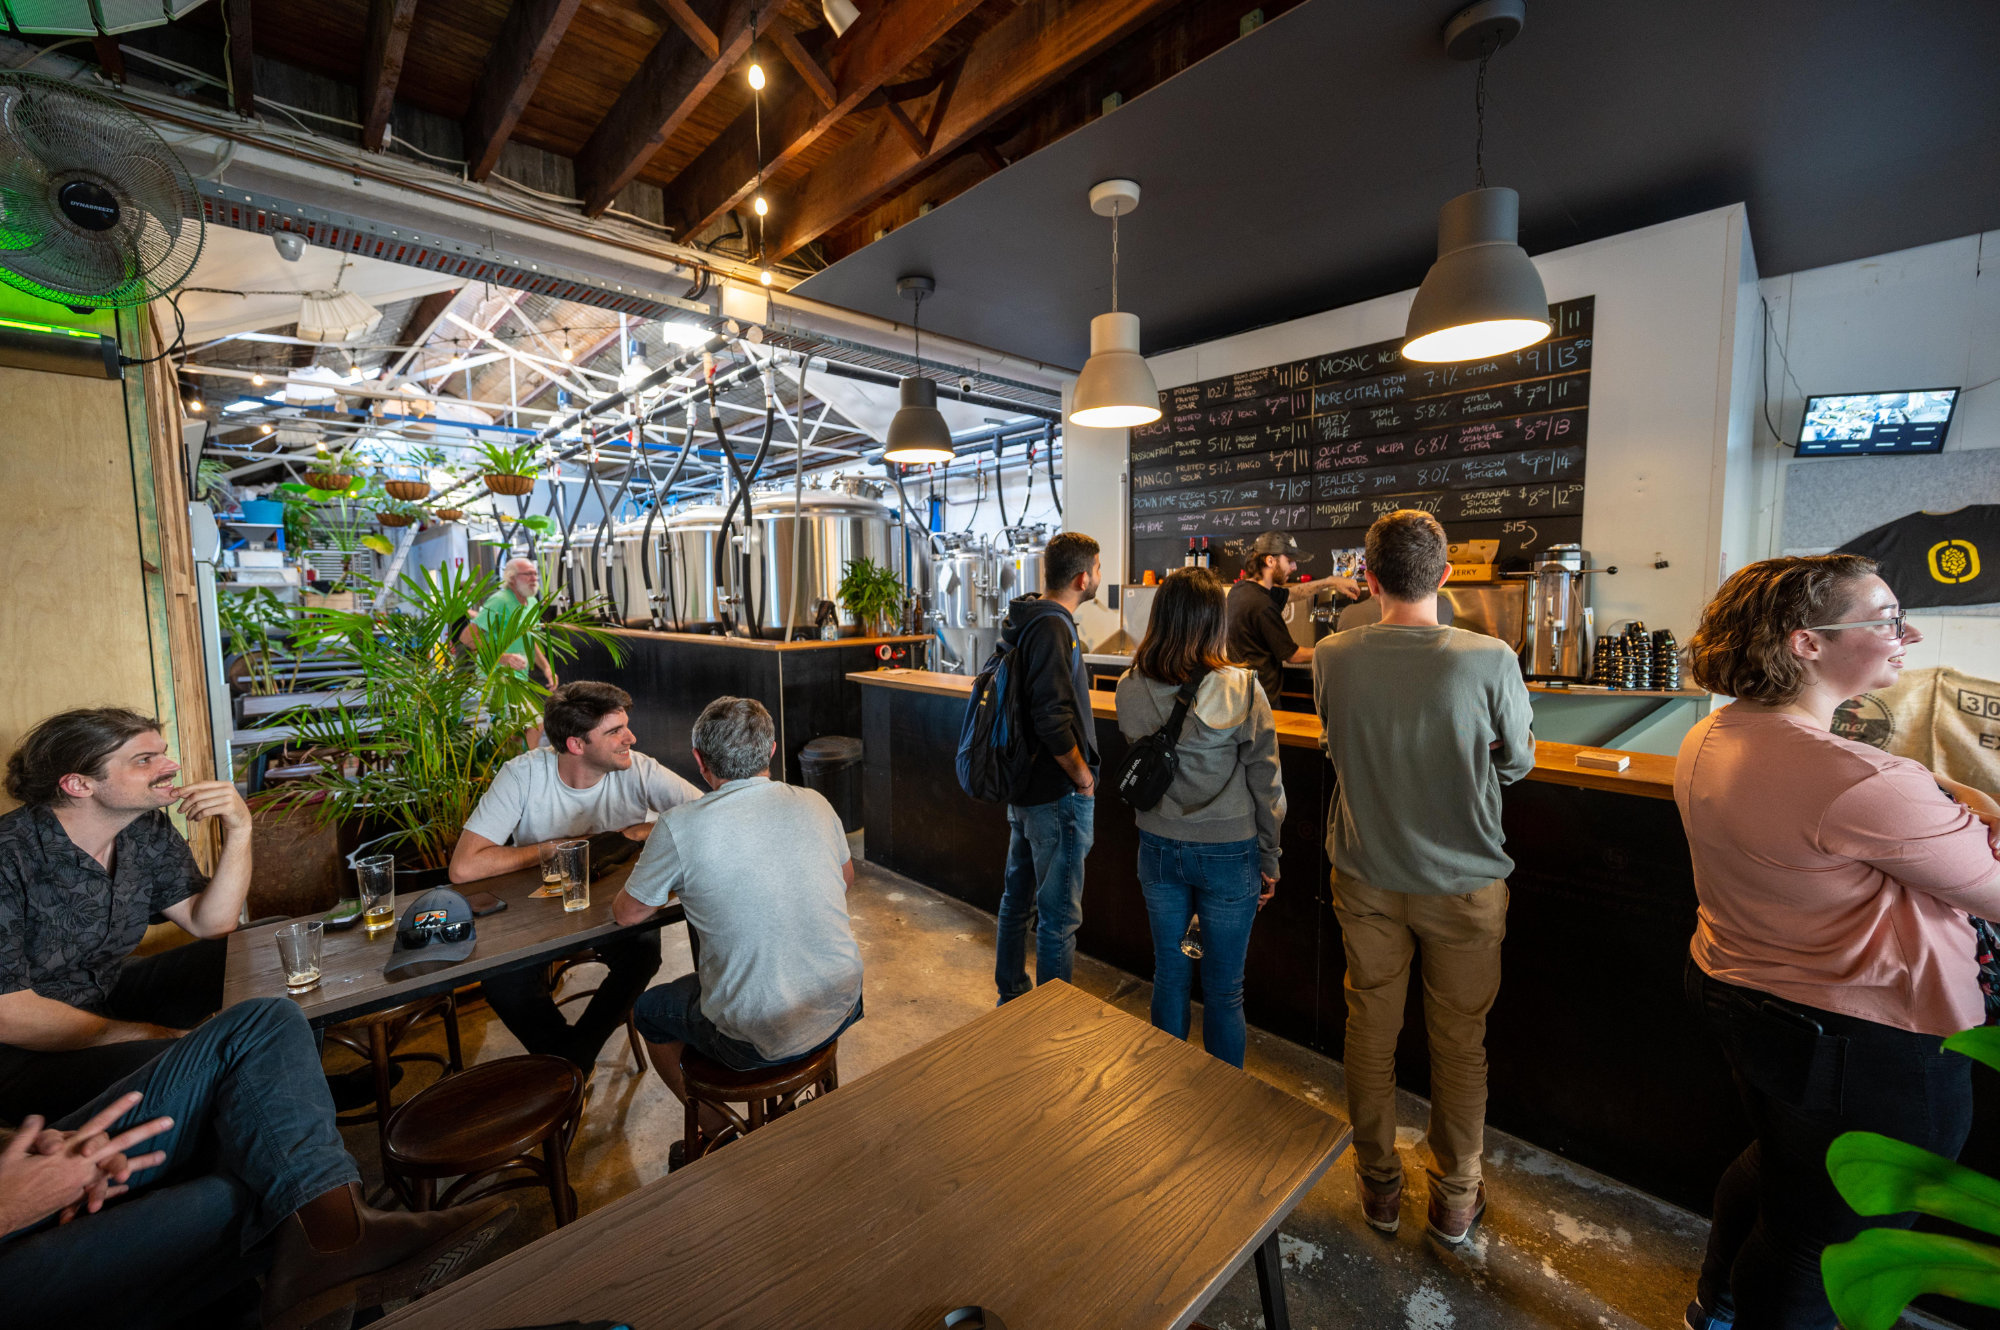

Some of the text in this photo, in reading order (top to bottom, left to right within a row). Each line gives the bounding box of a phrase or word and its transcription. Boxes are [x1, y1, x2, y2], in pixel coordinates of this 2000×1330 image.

[70, 200, 115, 213] DYNABREEZE
[1320, 354, 1373, 378] MOSAIC
[1466, 362, 1498, 376] CITRA
[1315, 391, 1343, 409] MORE
[1344, 384, 1380, 400] CITRA
[1384, 386, 1404, 399] IPA
[1318, 411, 1351, 429] HAZY
[1463, 392, 1490, 404] CITRA
[1134, 424, 1171, 439] PEACH
[1323, 424, 1351, 440] PALE
[1376, 416, 1401, 428] PALE
[1319, 444, 1344, 458] OUT
[1346, 441, 1362, 453] OF
[1314, 459, 1331, 470] THE
[1334, 454, 1368, 467] WOODS
[1134, 472, 1172, 488] MANGO
[1236, 460, 1261, 473] MANGO
[1318, 471, 1366, 489] DEALER'S
[1461, 458, 1506, 470] NELSON
[1321, 484, 1361, 498] CHOICE
[1316, 500, 1363, 516] MIDNIGHT
[1371, 500, 1400, 513] BLACK
[1460, 488, 1512, 500] CENTENNIAL
[1460, 506, 1502, 516] CHINOOK
[1330, 513, 1350, 528] DIP
[1502, 520, 1528, 534] $15
[1224, 538, 1245, 547] WINE
[1452, 568, 1477, 577] JERKY
